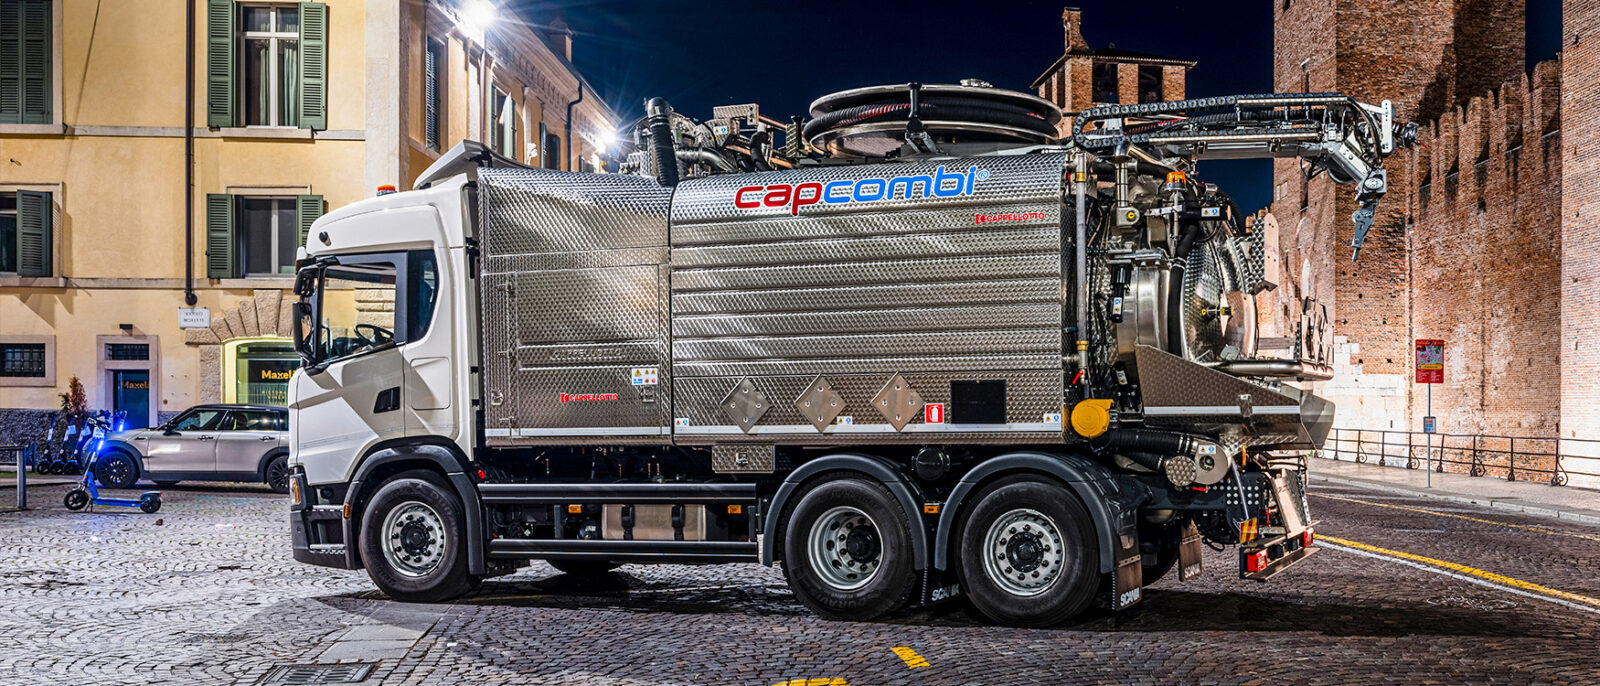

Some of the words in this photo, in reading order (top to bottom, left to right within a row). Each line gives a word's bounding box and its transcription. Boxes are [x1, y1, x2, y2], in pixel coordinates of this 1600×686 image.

[986, 212, 1045, 222] CAPPELLOTTO
[261, 369, 296, 380] Maxel
[569, 393, 619, 402] CAPPELLOTTO
[1120, 587, 1140, 607] SCANIA
